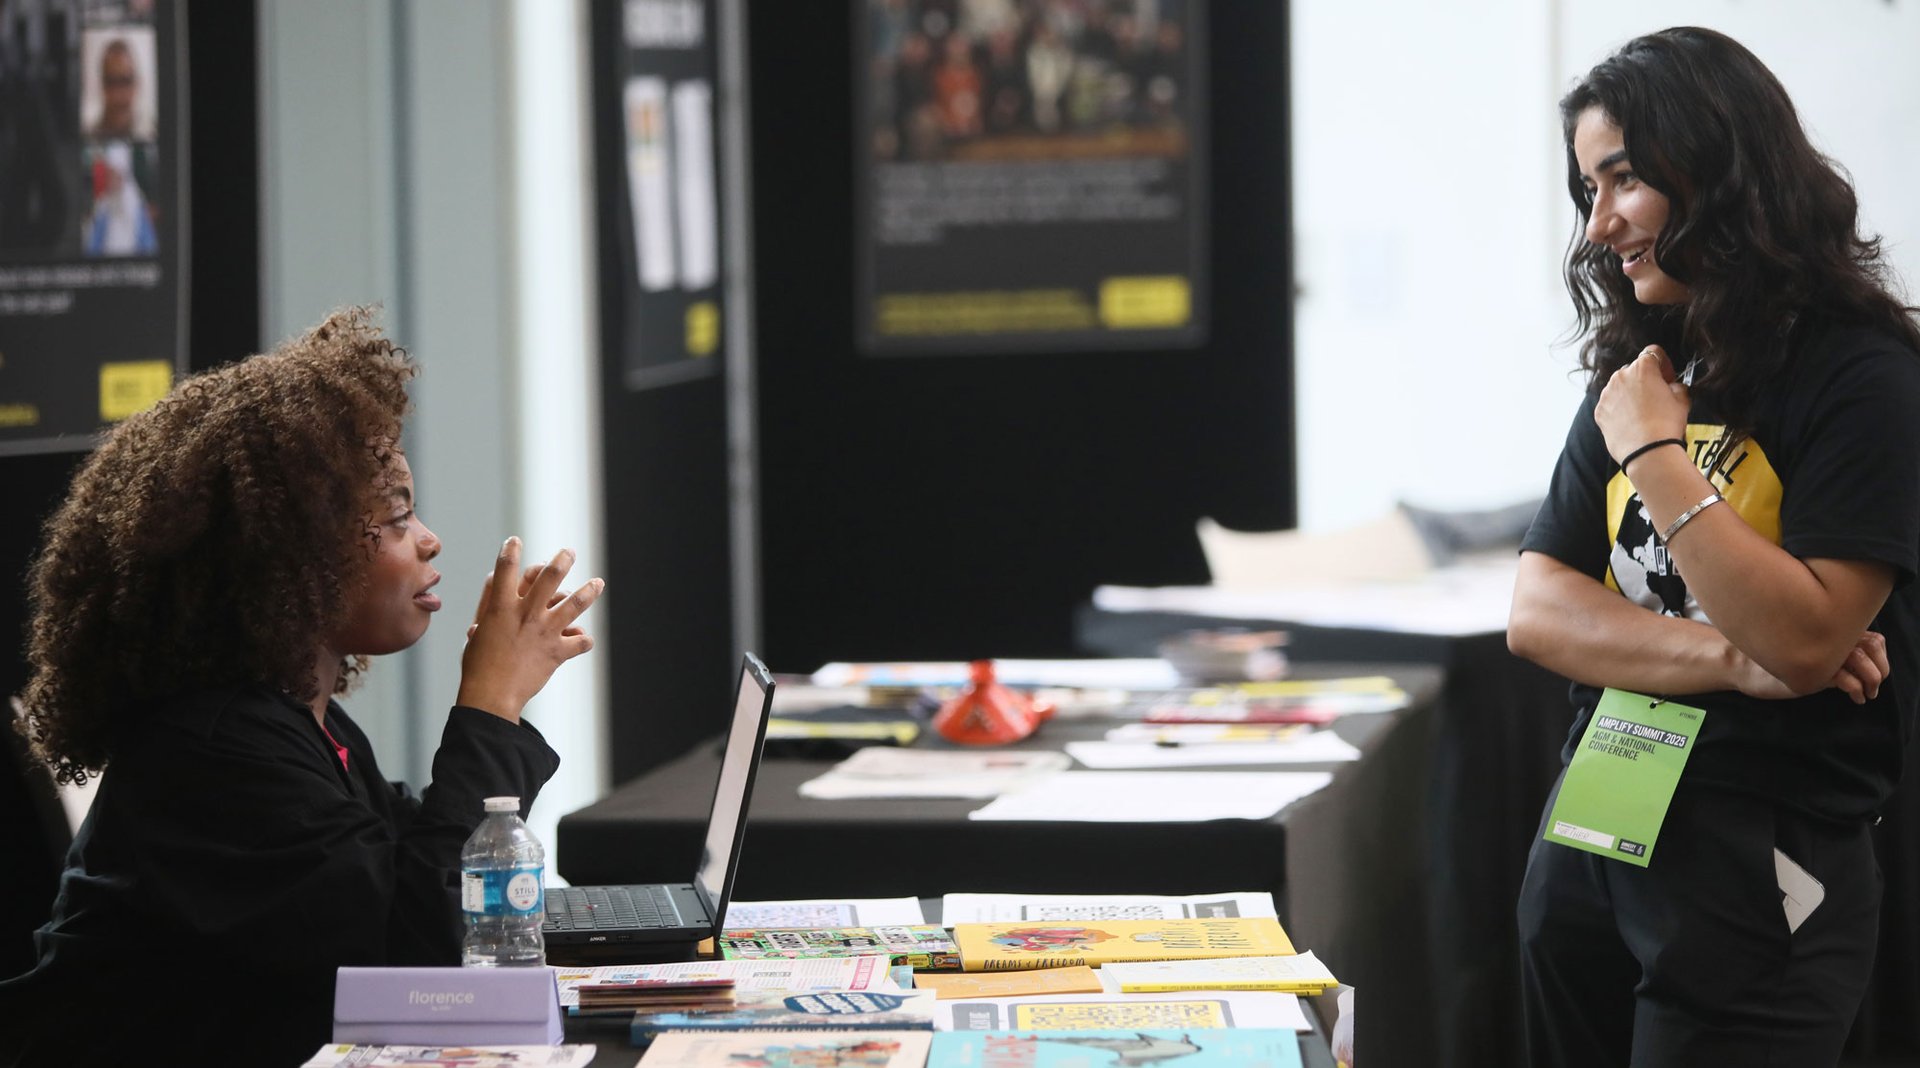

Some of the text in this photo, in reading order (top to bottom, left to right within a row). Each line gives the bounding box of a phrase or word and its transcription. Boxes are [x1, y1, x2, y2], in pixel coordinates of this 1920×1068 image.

[1592, 730, 1656, 755] AGM & NATIONAL
[1598, 717, 1687, 747] AMPLIFY SUMMIT 2025
[1588, 740, 1640, 761] CONFERENCE
[983, 959, 1021, 970] DREAMS
[1035, 957, 1086, 969] FREEDOM
[408, 990, 475, 1005] florence
